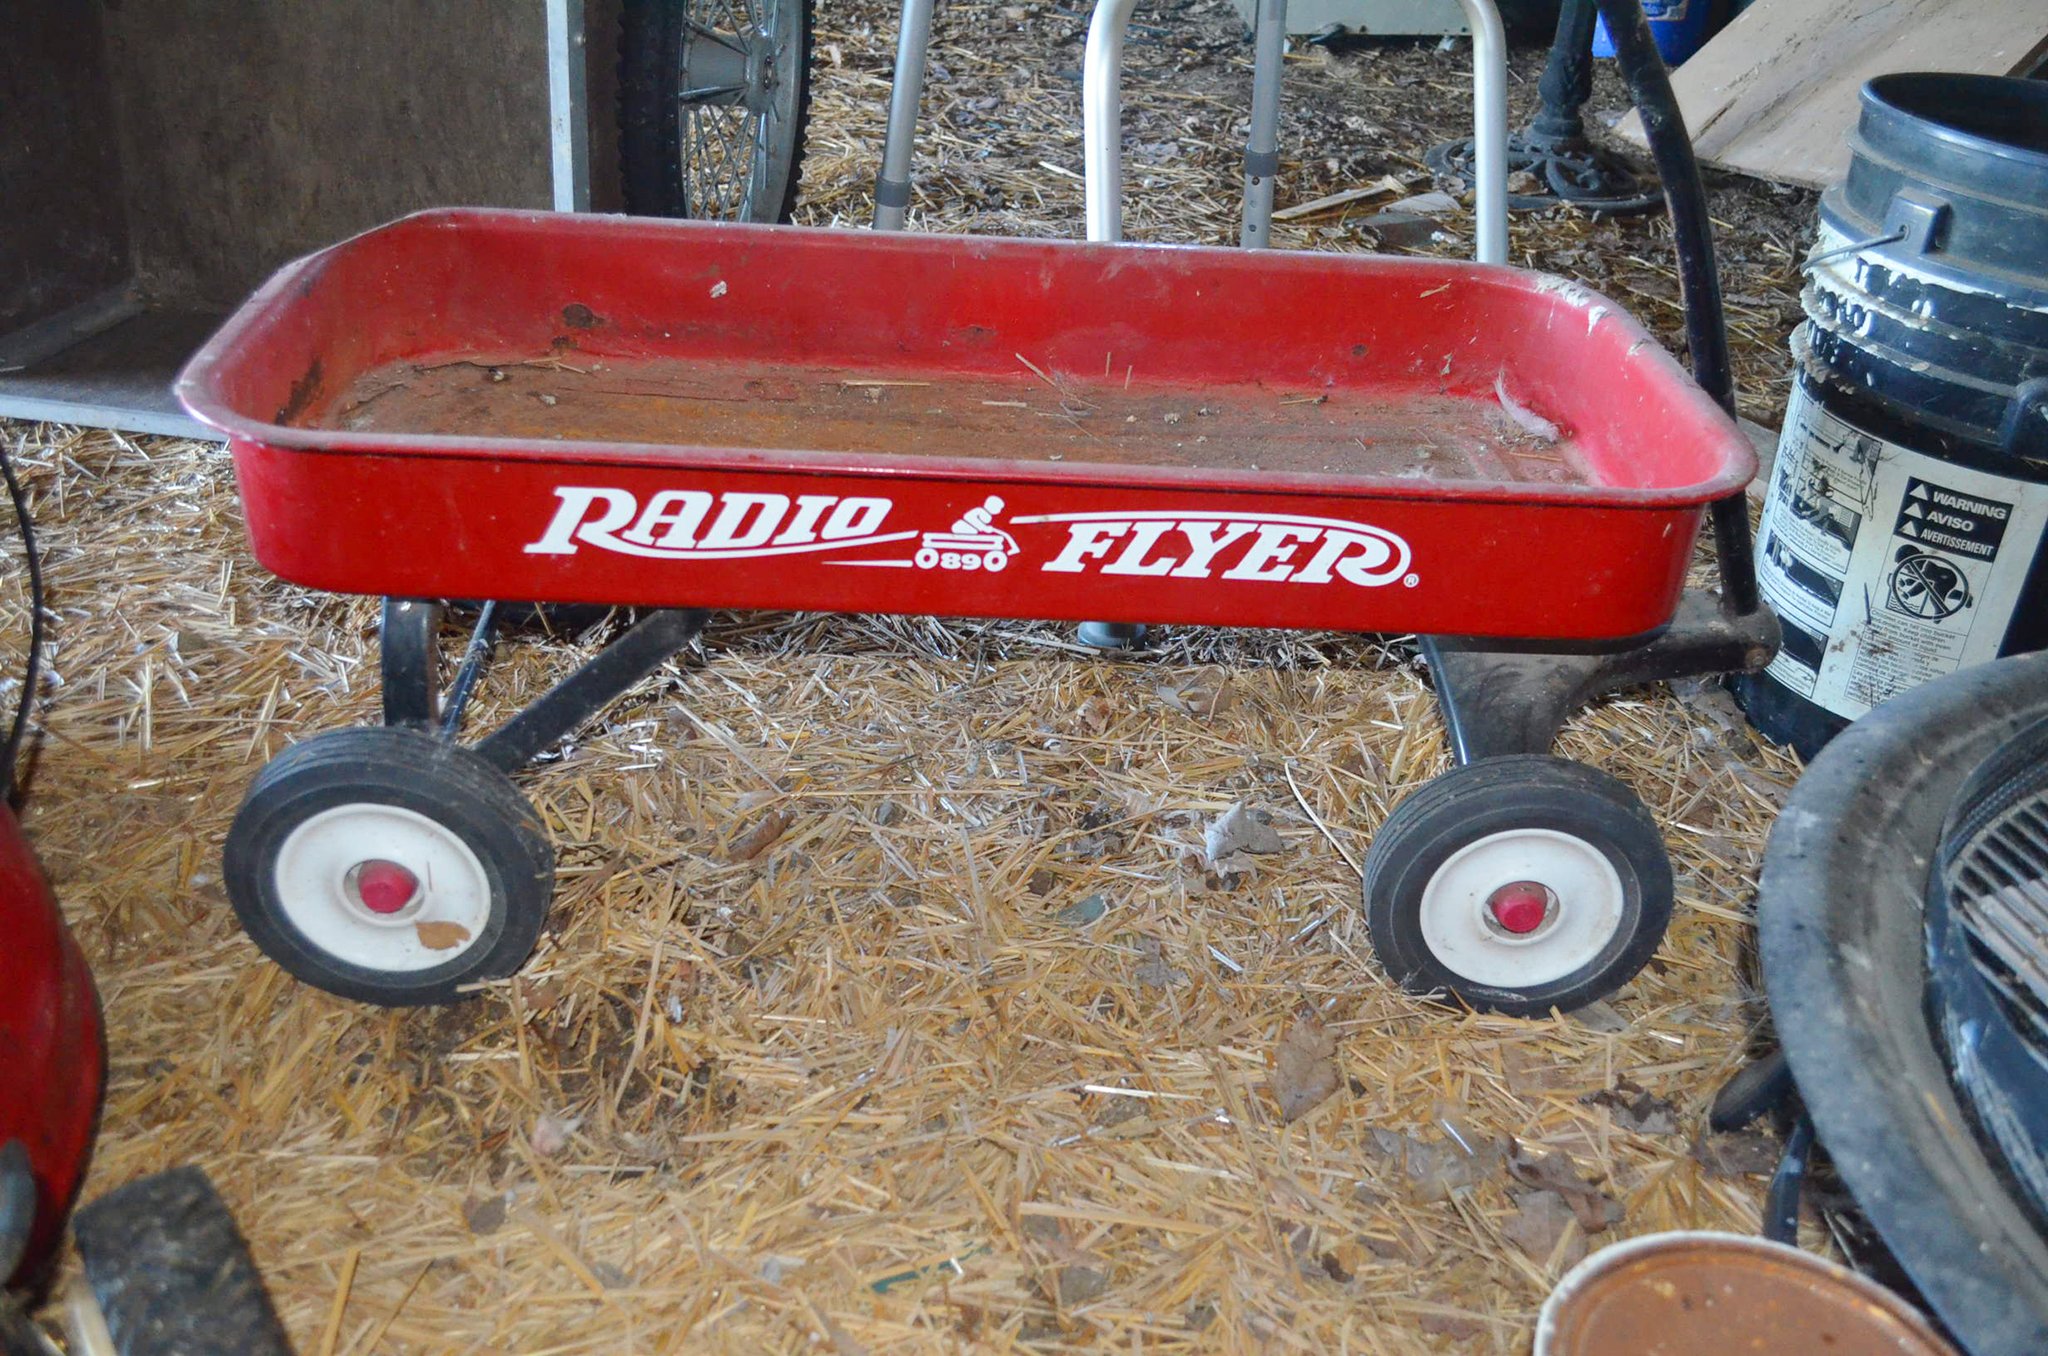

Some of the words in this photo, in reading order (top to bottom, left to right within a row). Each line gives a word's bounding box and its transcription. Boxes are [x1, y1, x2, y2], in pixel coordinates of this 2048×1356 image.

[1932, 491, 2007, 519] WARNING
[1926, 510, 1975, 532] AVISO
[522, 485, 918, 559] RADIO
[1035, 511, 1412, 588] FLYER
[1920, 528, 1995, 556] AVERTISSEMENT
